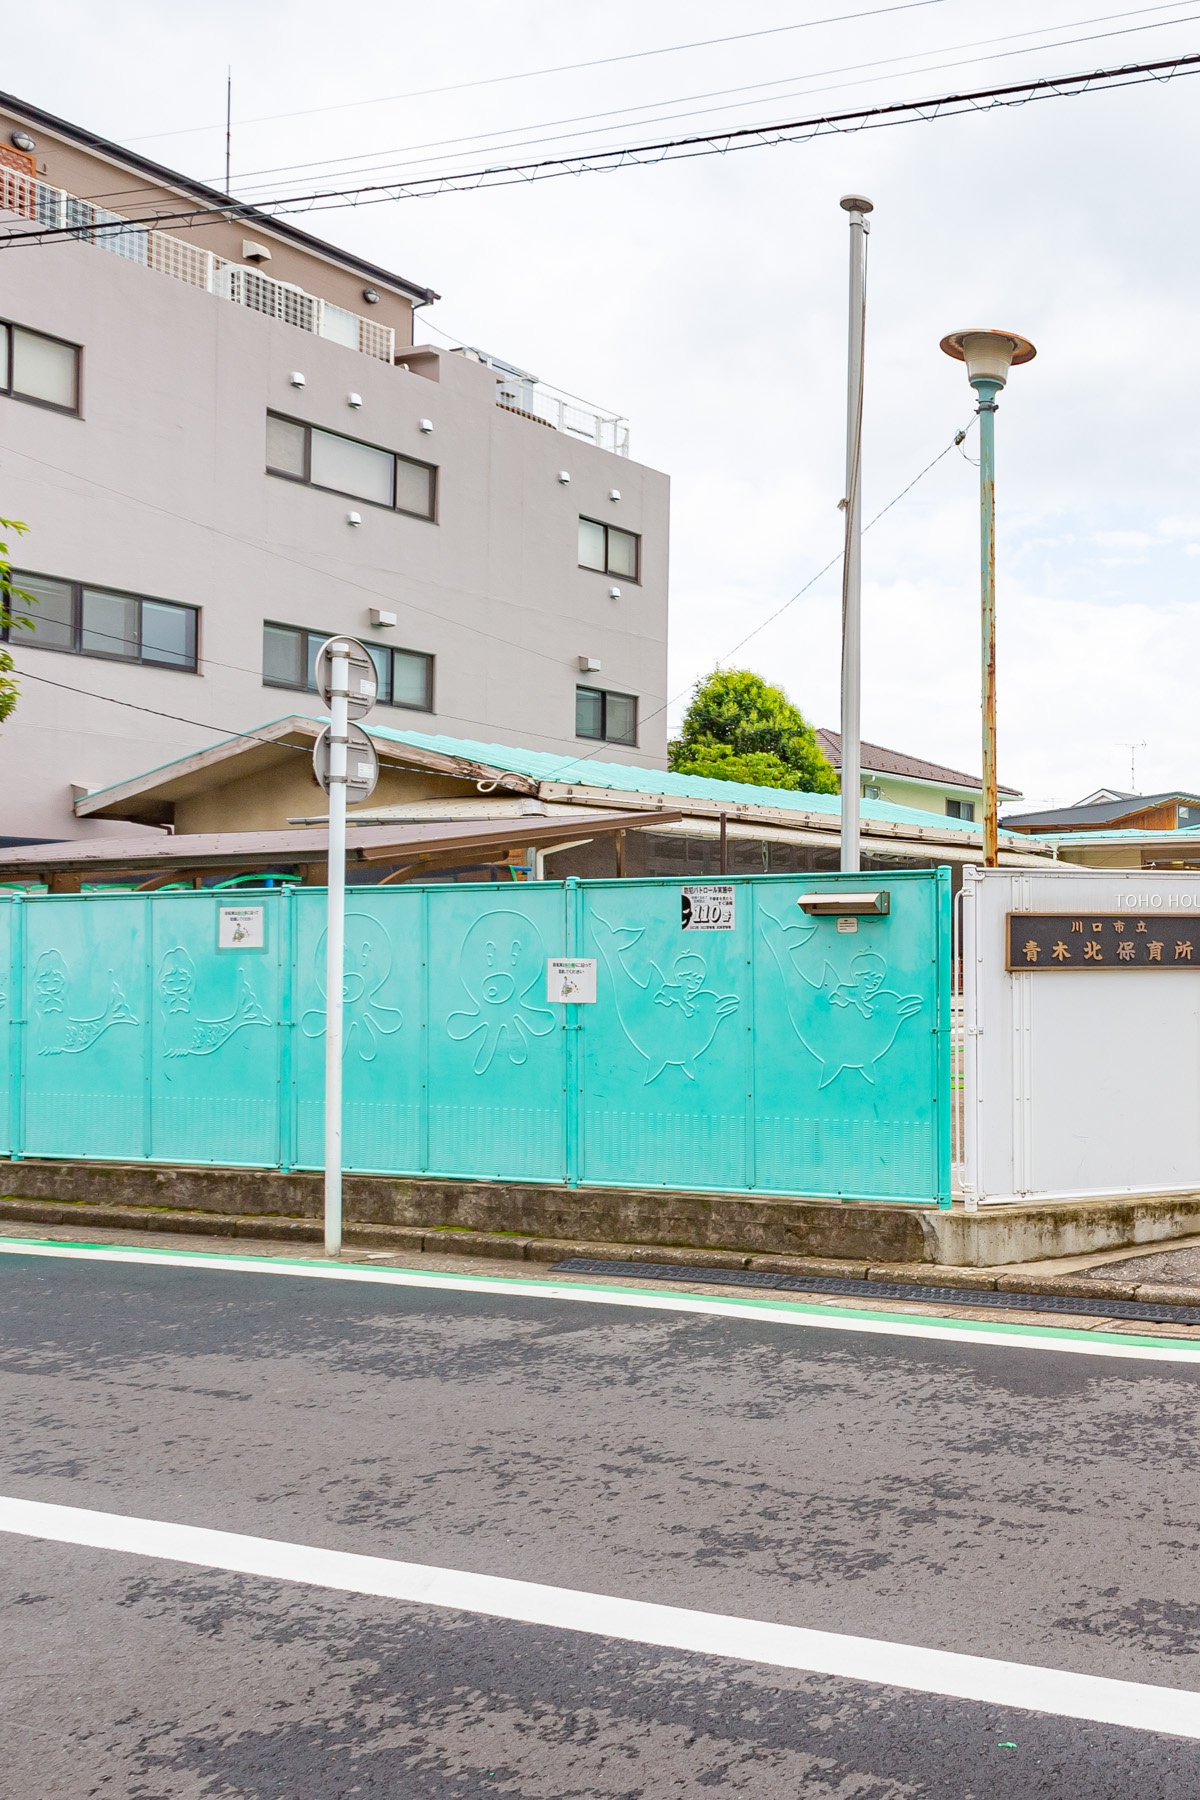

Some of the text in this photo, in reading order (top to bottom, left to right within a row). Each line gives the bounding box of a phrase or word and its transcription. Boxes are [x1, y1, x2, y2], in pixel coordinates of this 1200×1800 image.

[1071, 920, 1148, 933] 川口市立
[1022, 939, 1194, 963] 青木北保育所
